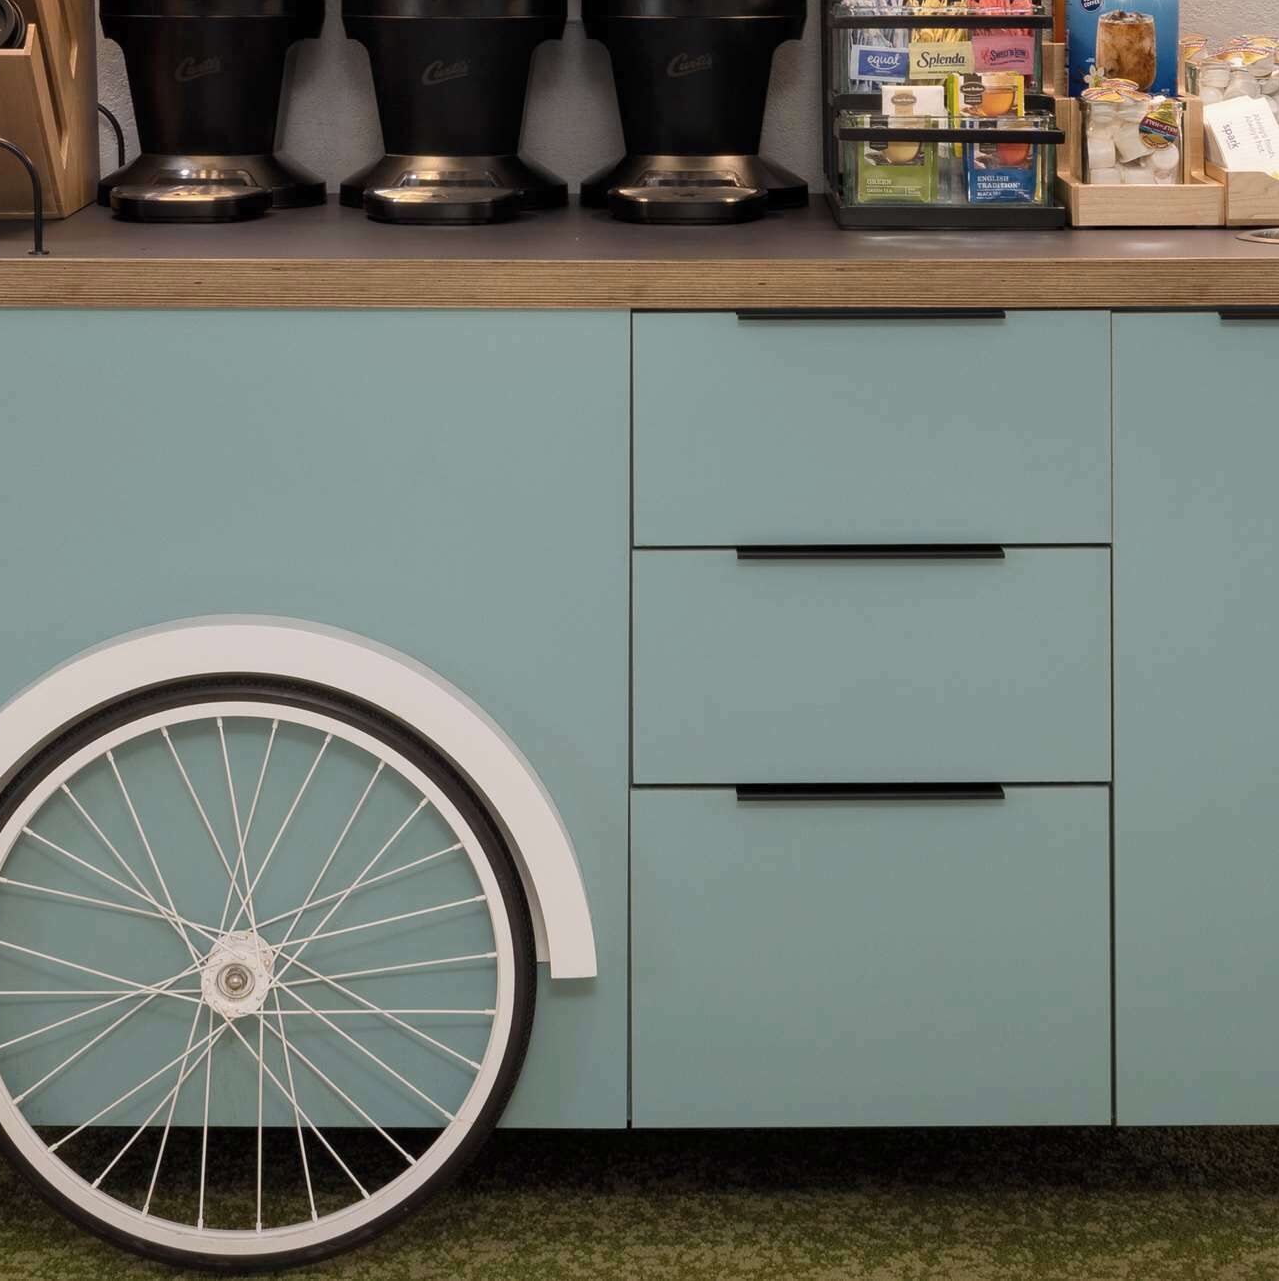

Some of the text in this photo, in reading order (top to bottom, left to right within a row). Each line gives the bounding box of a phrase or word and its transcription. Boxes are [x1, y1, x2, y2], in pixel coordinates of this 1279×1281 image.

[1083, 0, 1100, 8] COFFEE
[867, 53, 901, 68] equal
[917, 51, 966, 69] Splenda
